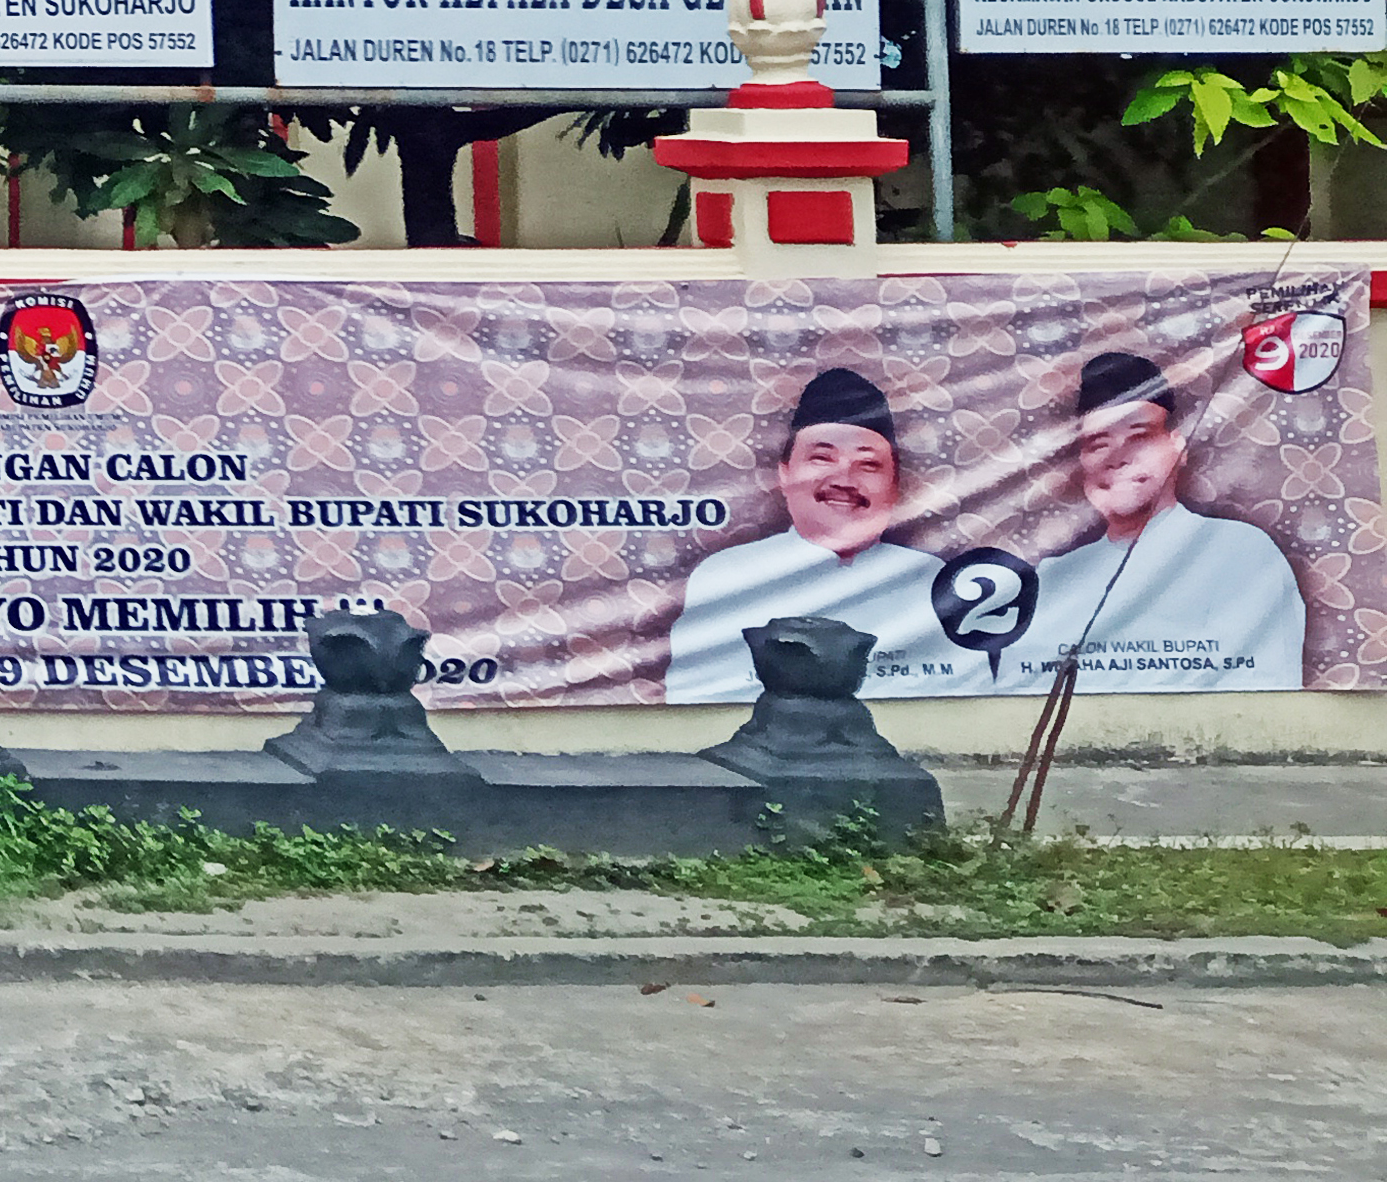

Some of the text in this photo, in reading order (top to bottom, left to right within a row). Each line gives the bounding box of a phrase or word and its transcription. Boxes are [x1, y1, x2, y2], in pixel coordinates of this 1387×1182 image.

[52, 32, 102, 50] KODE
[107, 32, 143, 51] POS
[148, 32, 196, 50] 57552
[975, 18, 1023, 37] JALAN
[1026, 18, 1077, 37] DUREN
[1164, 17, 1206, 37] (0271)
[1208, 18, 1256, 36] 626472
[1258, 18, 1299, 37] KODE
[1302, 18, 1332, 37] POS
[1335, 18, 1375, 37] 57552
[290, 39, 358, 62] JALAN
[362, 39, 434, 63] DUREN
[561, 37, 620, 67] (0271)
[626, 40, 694, 65] 626472
[699, 41, 746, 65] KOD
[810, 42, 867, 65] 57552
[14, 297, 75, 309] KOMISI
[1254, 336, 1290, 371] 9
[1299, 342, 1340, 359] 2020
[75, 355, 96, 400] UMUM
[106, 453, 247, 482] CALON
[35, 498, 123, 526] DAN
[135, 499, 275, 527] WAKIL
[287, 500, 445, 527] BUPATI
[457, 499, 727, 528] SUKOHARJO
[93, 547, 192, 573] 2020
[954, 562, 1022, 636] 2
[61, 597, 320, 633] MEMILIH
[1111, 639, 1220, 653] WAKIL BUPATI
[42, 654, 319, 689] DESEMBE
[414, 656, 499, 685] 020
[1108, 658, 1133, 671] AJI
